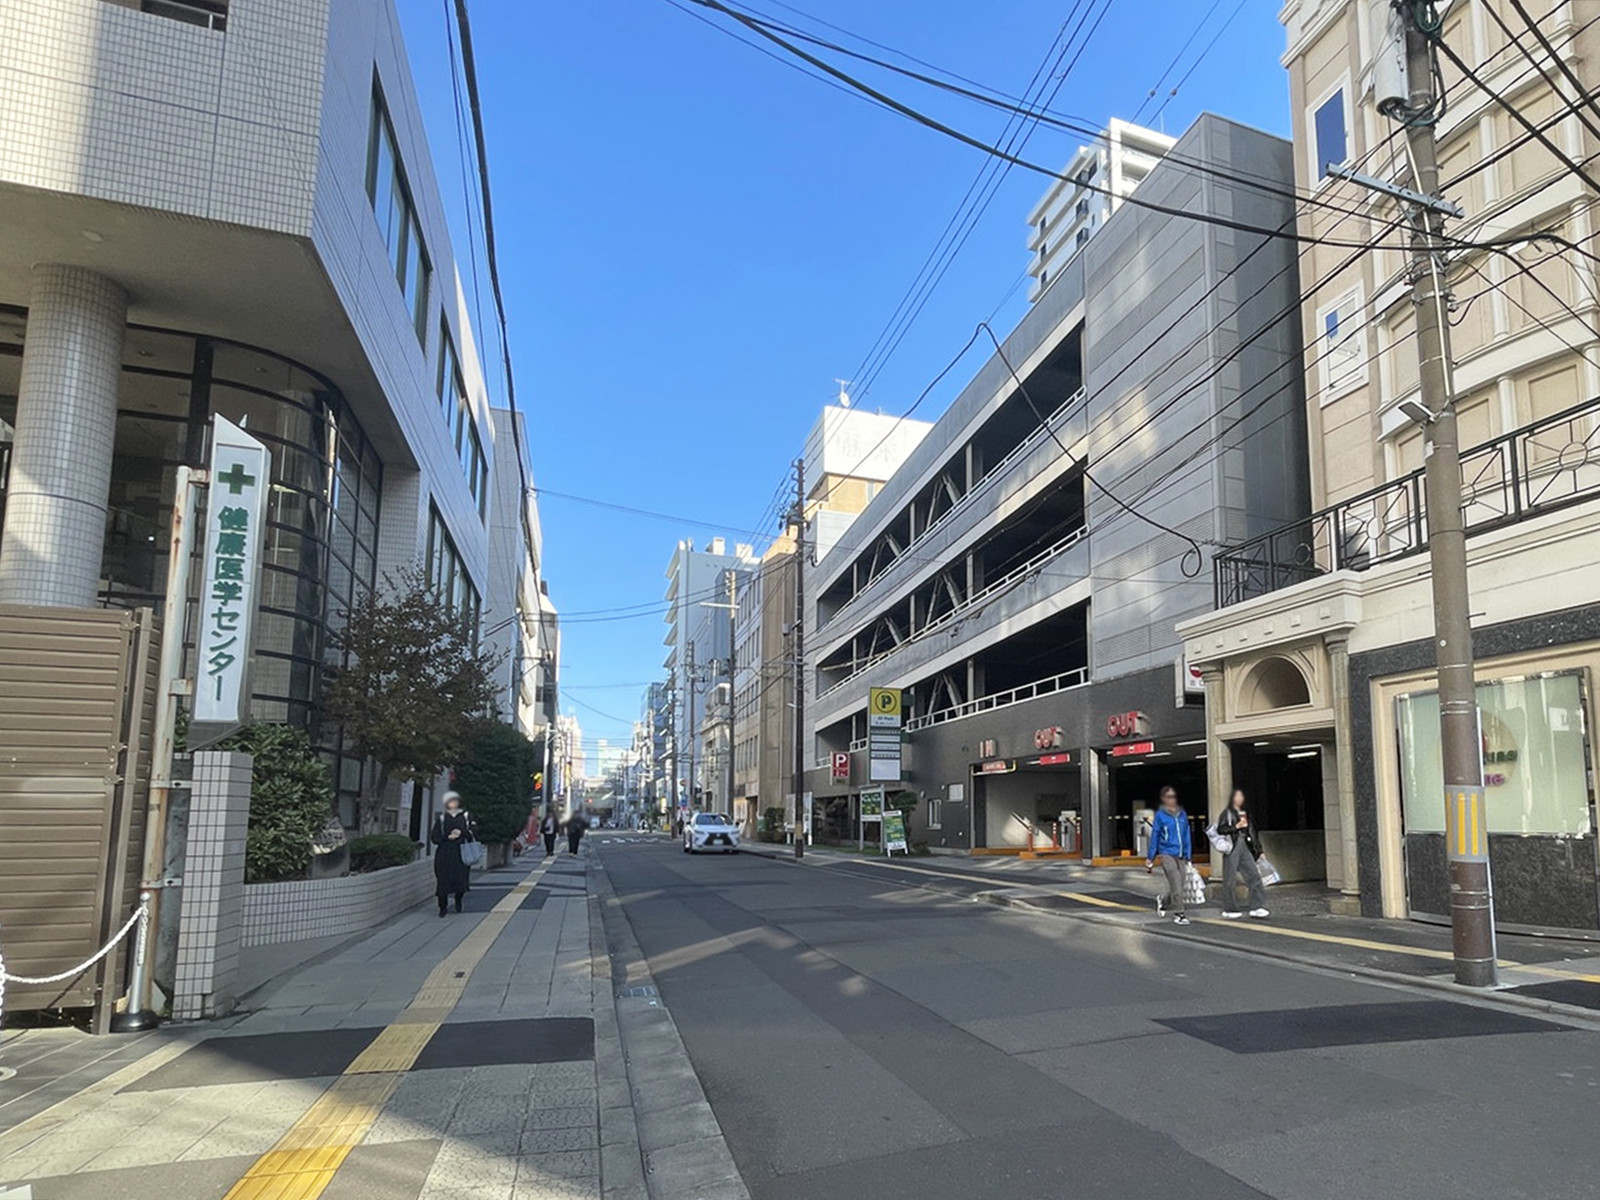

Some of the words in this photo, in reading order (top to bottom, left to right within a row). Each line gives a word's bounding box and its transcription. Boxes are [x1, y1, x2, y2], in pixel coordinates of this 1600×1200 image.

[207, 505, 249, 702] 健康医学センター
[881, 695, 892, 709] P
[1108, 711, 1138, 737] OUT
[1034, 726, 1057, 749] OUT
[979, 740, 993, 758] IN
[835, 754, 847, 768] P
